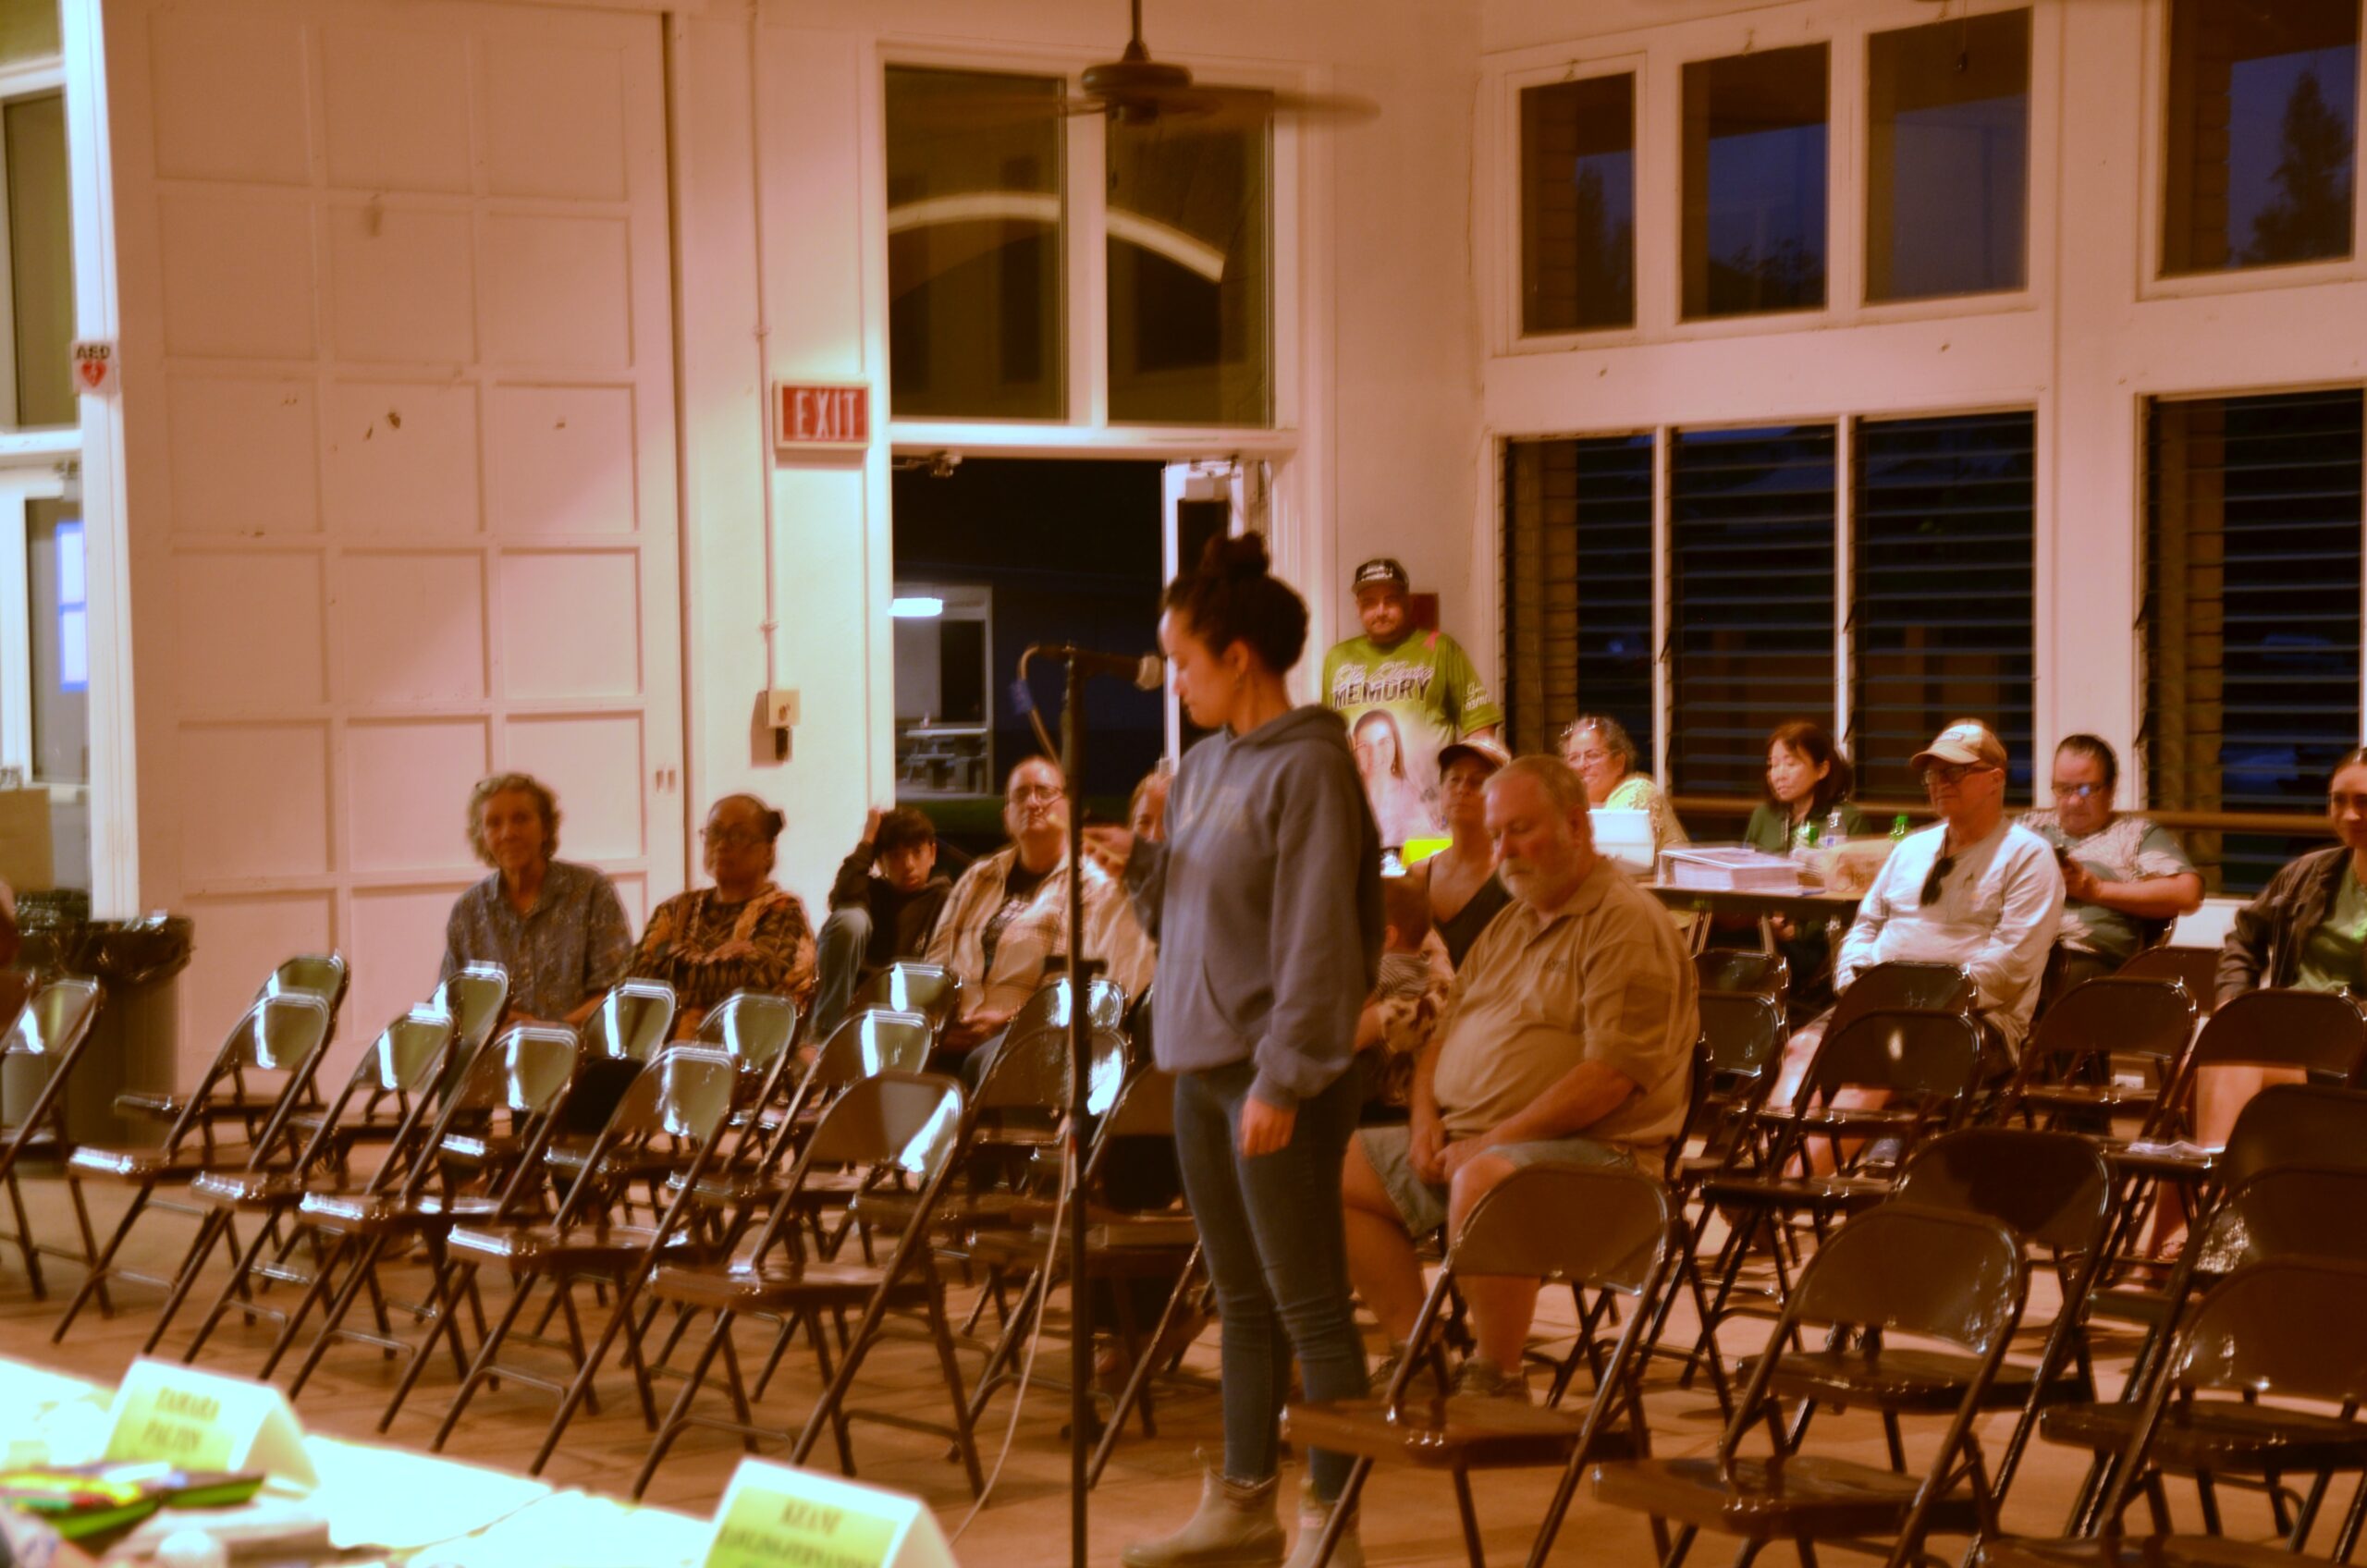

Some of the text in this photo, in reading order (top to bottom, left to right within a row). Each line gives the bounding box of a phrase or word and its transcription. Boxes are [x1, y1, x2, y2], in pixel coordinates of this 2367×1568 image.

[76, 345, 111, 361] AED
[795, 389, 858, 439] EXIT
[1333, 677, 1432, 710] MEMORY
